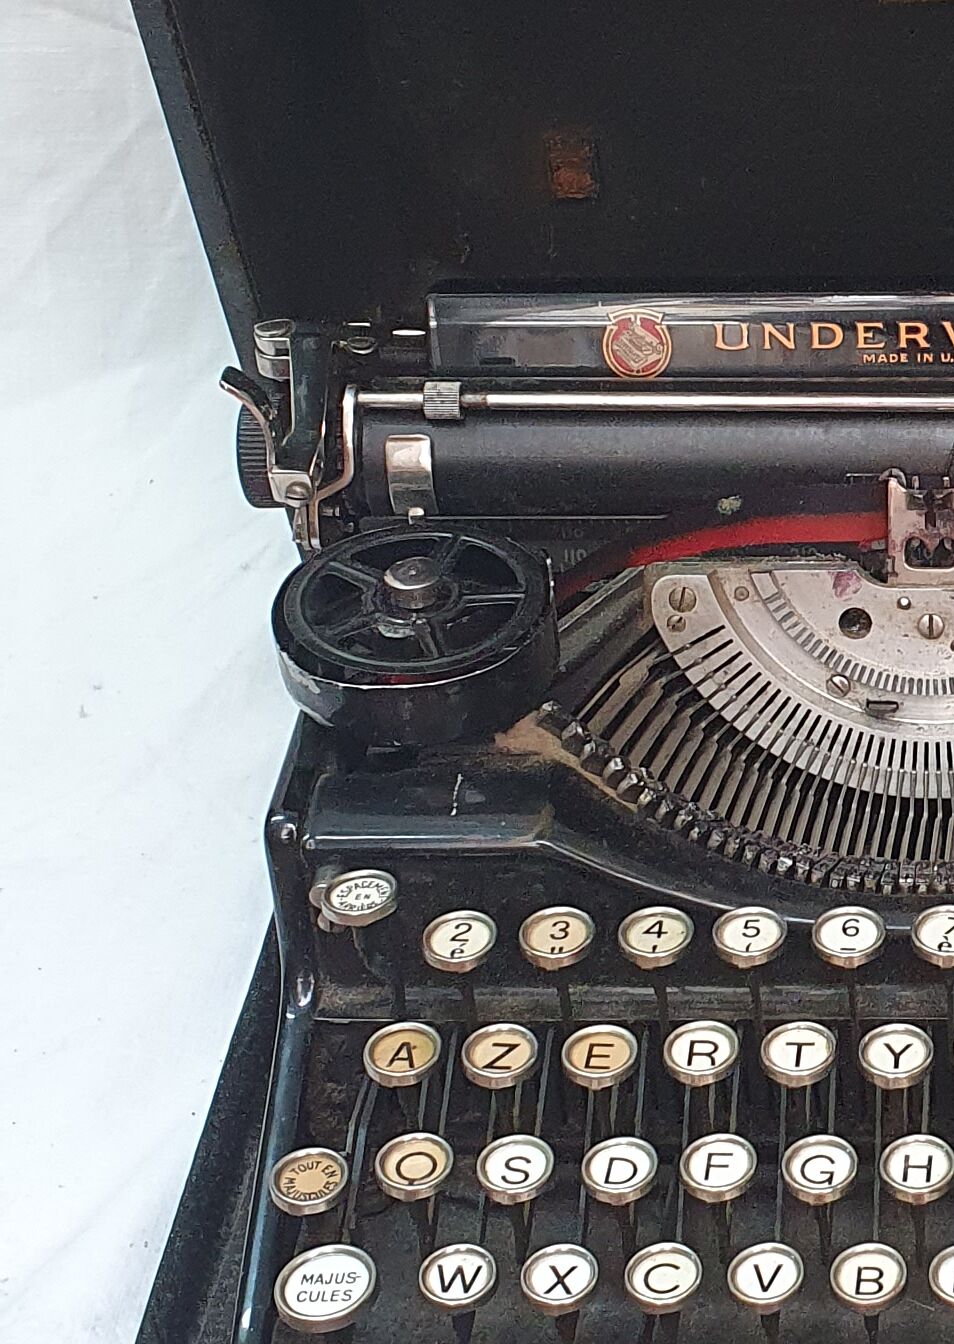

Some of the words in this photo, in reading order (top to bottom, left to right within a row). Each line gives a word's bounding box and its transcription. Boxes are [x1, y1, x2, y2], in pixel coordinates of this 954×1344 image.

[863, 353, 909, 364] MADE
[917, 353, 934, 364] IN
[450, 922, 472, 942] 2
[550, 920, 570, 940] 3
[642, 920, 668, 939] 4
[741, 919, 761, 938] 5
[841, 918, 860, 937] 6
[386, 1041, 415, 1070] A
[482, 1042, 521, 1070] Z
[584, 1043, 615, 1070] E
[686, 1039, 719, 1067] R
[785, 1042, 816, 1068] T
[883, 1042, 914, 1069] Y
[289, 1160, 322, 1176] TOUT
[321, 1164, 339, 1179] EN
[394, 1150, 438, 1185] Q
[501, 1156, 531, 1185] S
[604, 1157, 638, 1185] D
[703, 1152, 733, 1181] F
[800, 1155, 835, 1185] G
[902, 1154, 933, 1183] H
[283, 1176, 338, 1201] MAJUSCULES
[301, 1271, 362, 1285] MAJUS-
[437, 1264, 483, 1294] W
[544, 1265, 578, 1295] X
[643, 1262, 682, 1295] C
[753, 1263, 783, 1292] V
[854, 1266, 884, 1296] B
[296, 1289, 353, 1303] CULES
